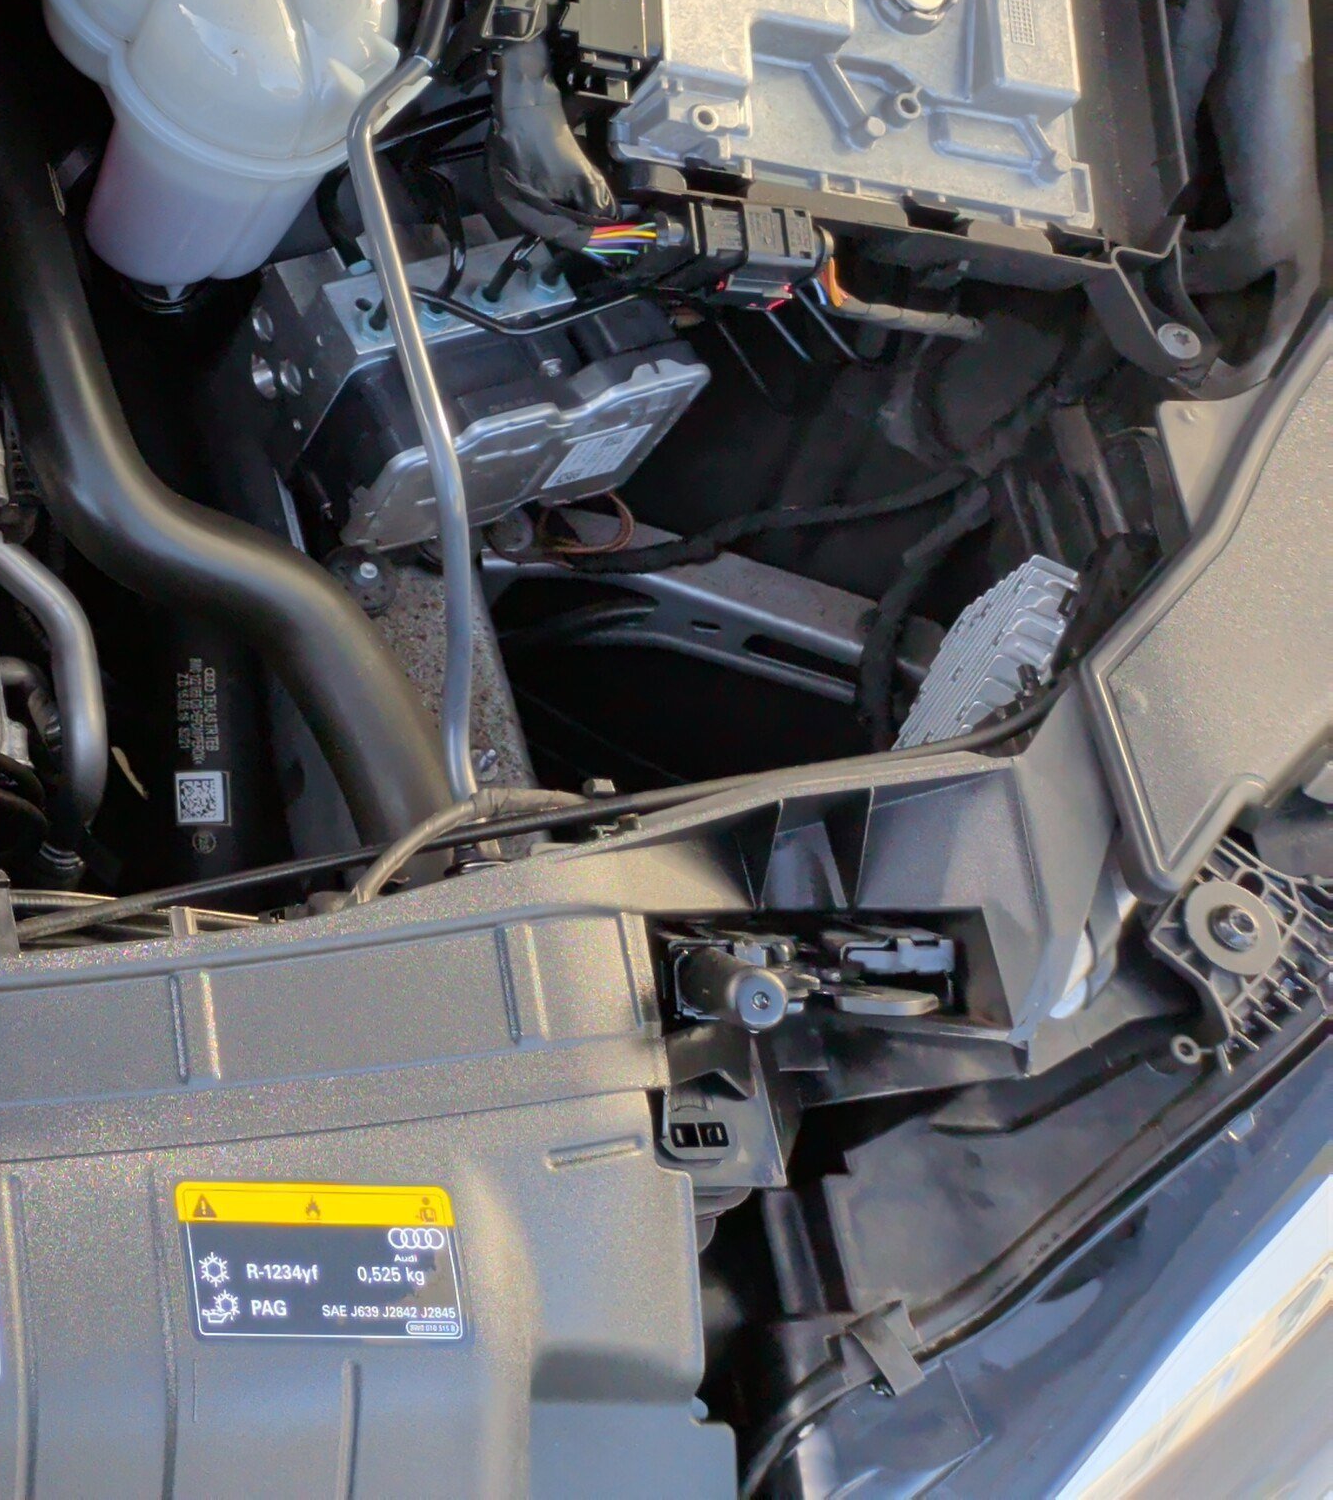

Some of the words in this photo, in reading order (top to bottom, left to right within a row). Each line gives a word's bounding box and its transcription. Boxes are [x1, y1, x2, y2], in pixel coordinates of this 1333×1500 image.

[394, 1254, 418, 1263] Audi
[246, 1264, 318, 1284] R-1234yf
[357, 1266, 401, 1283] 0,525
[405, 1266, 425, 1286] kg
[251, 1300, 287, 1317] PAG
[322, 1305, 347, 1317] SAE
[351, 1305, 379, 1318] J639
[421, 1306, 455, 1319] J2845
